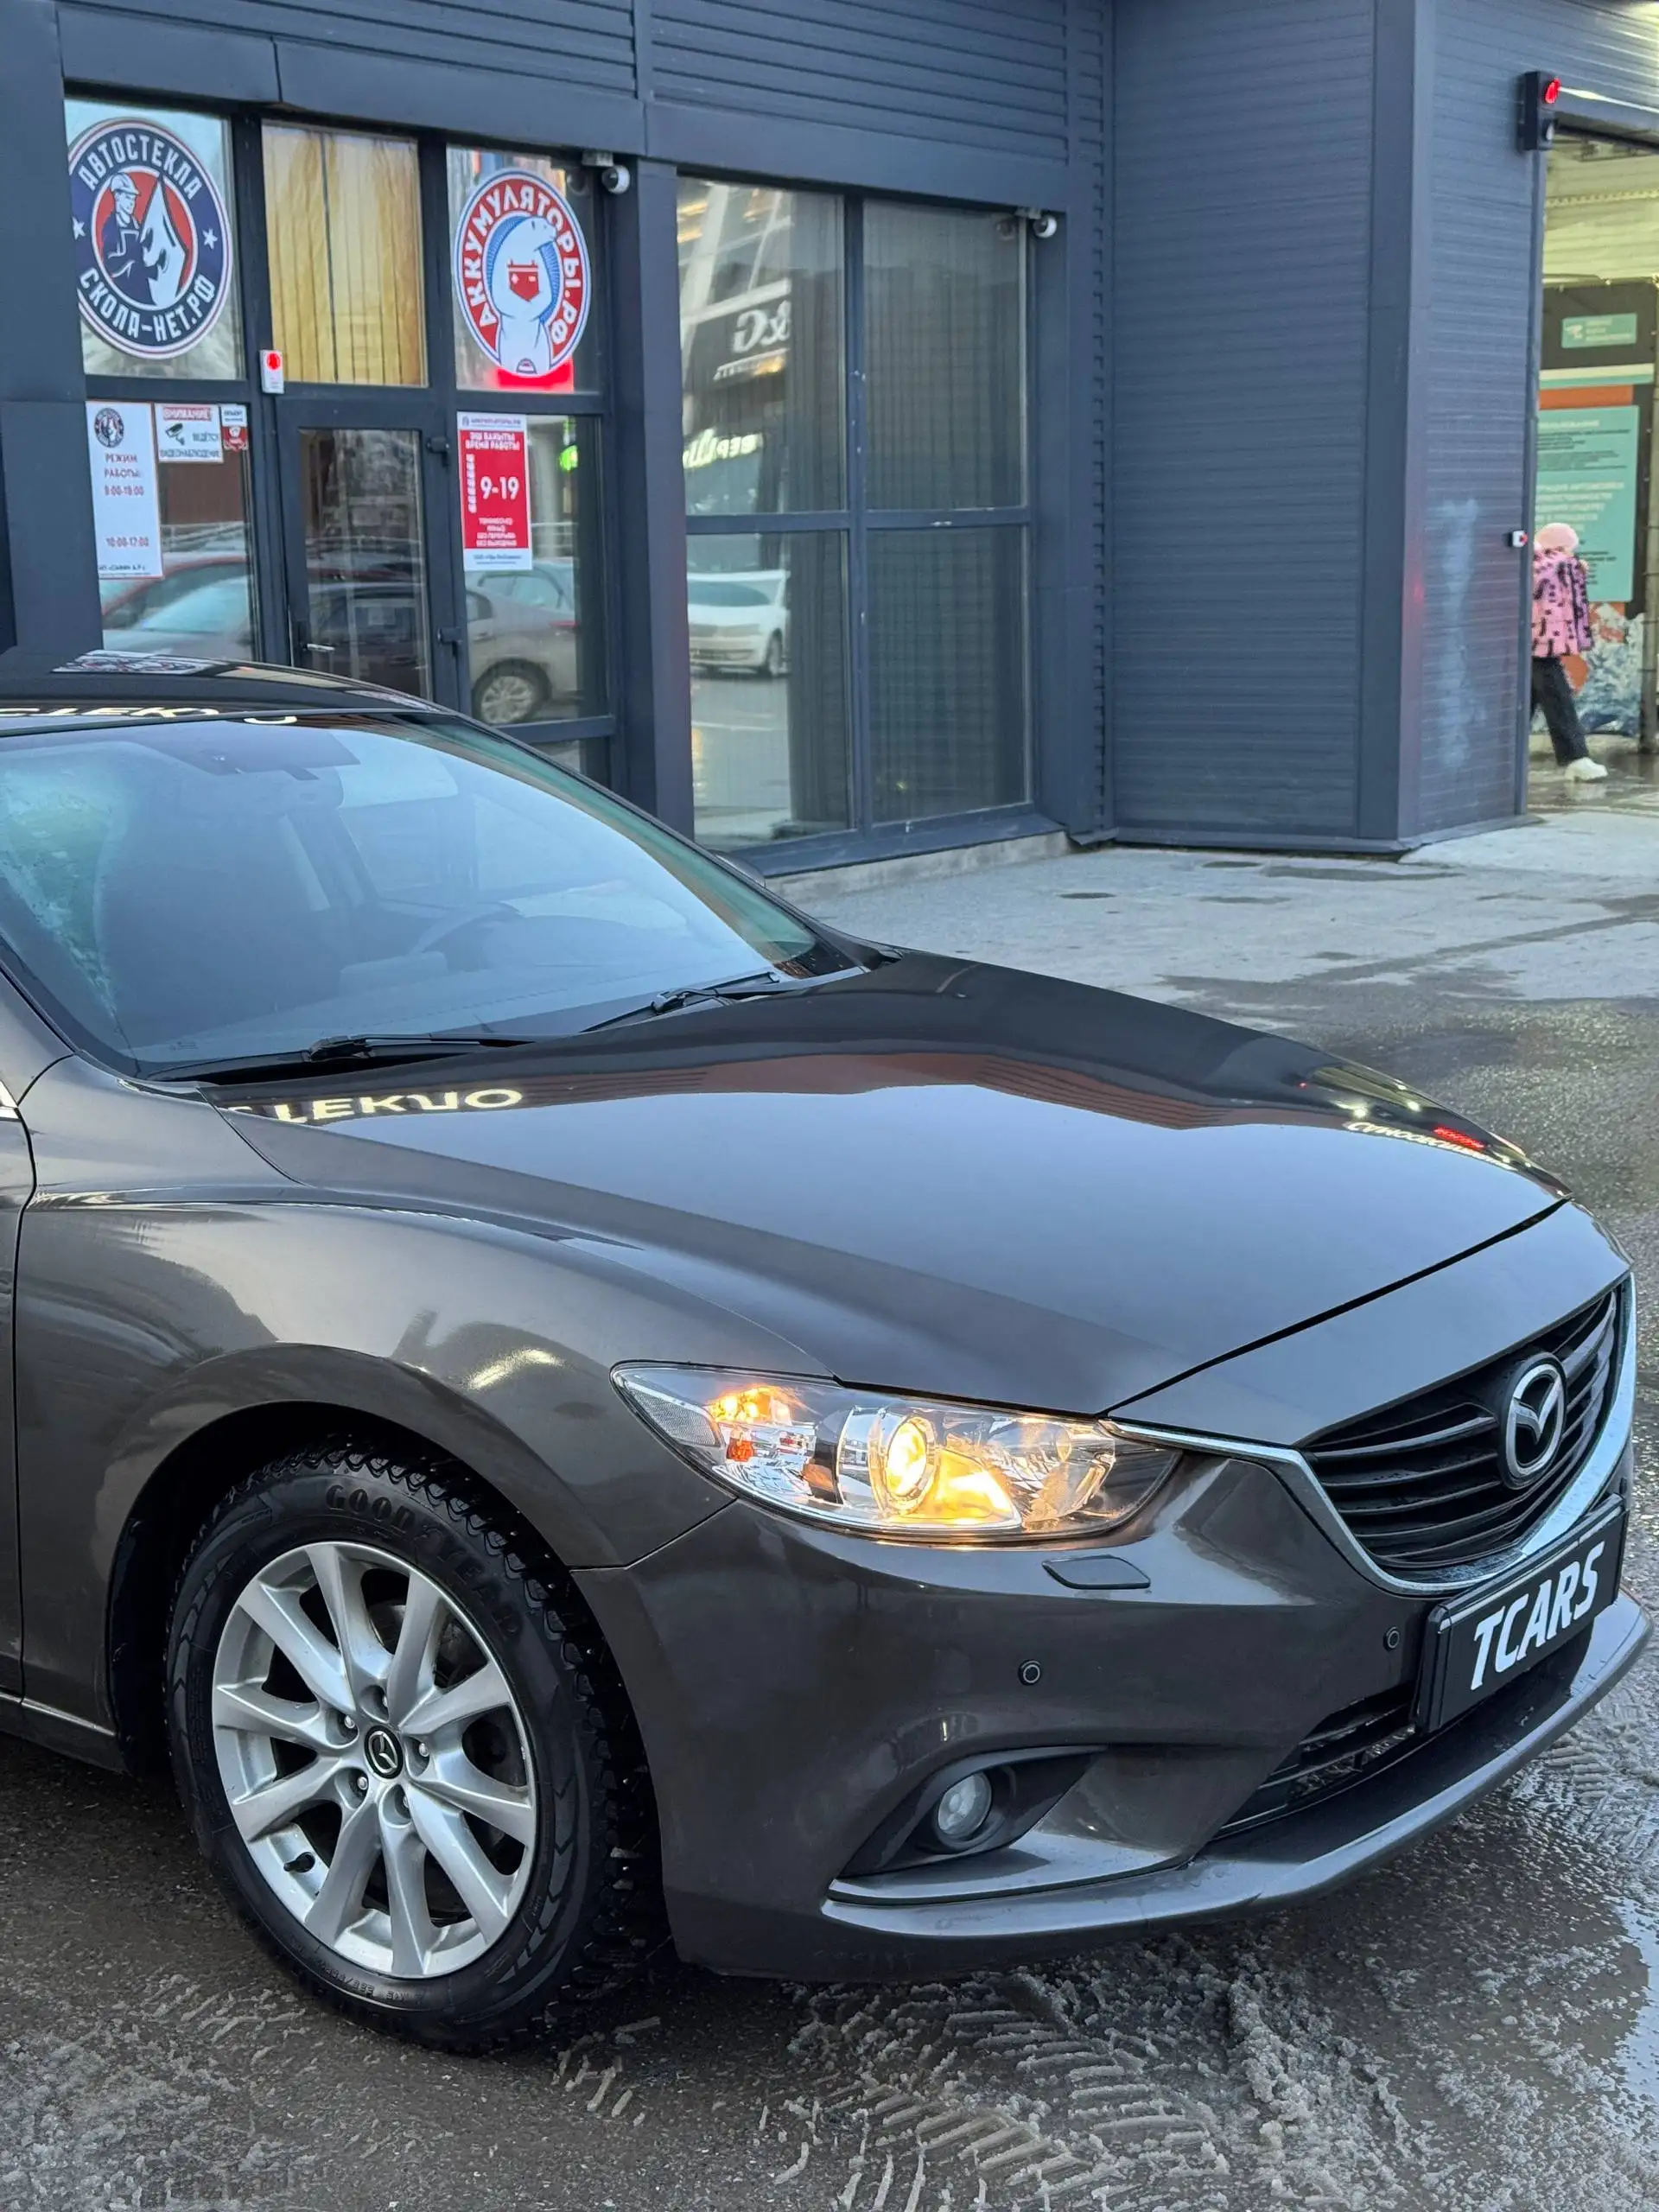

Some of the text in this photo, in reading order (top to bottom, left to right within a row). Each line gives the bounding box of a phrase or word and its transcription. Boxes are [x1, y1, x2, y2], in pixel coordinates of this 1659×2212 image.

[78, 133, 202, 200] АВТОСТЕКЛА
[464, 184, 582, 346] АККУМУЛЯТОРЫ.РФ
[79, 267, 216, 341] СКОЛА-НЕТ.РФ
[480, 475, 520, 500] 9-19
[1471, 1541, 1605, 1691] TCARS
